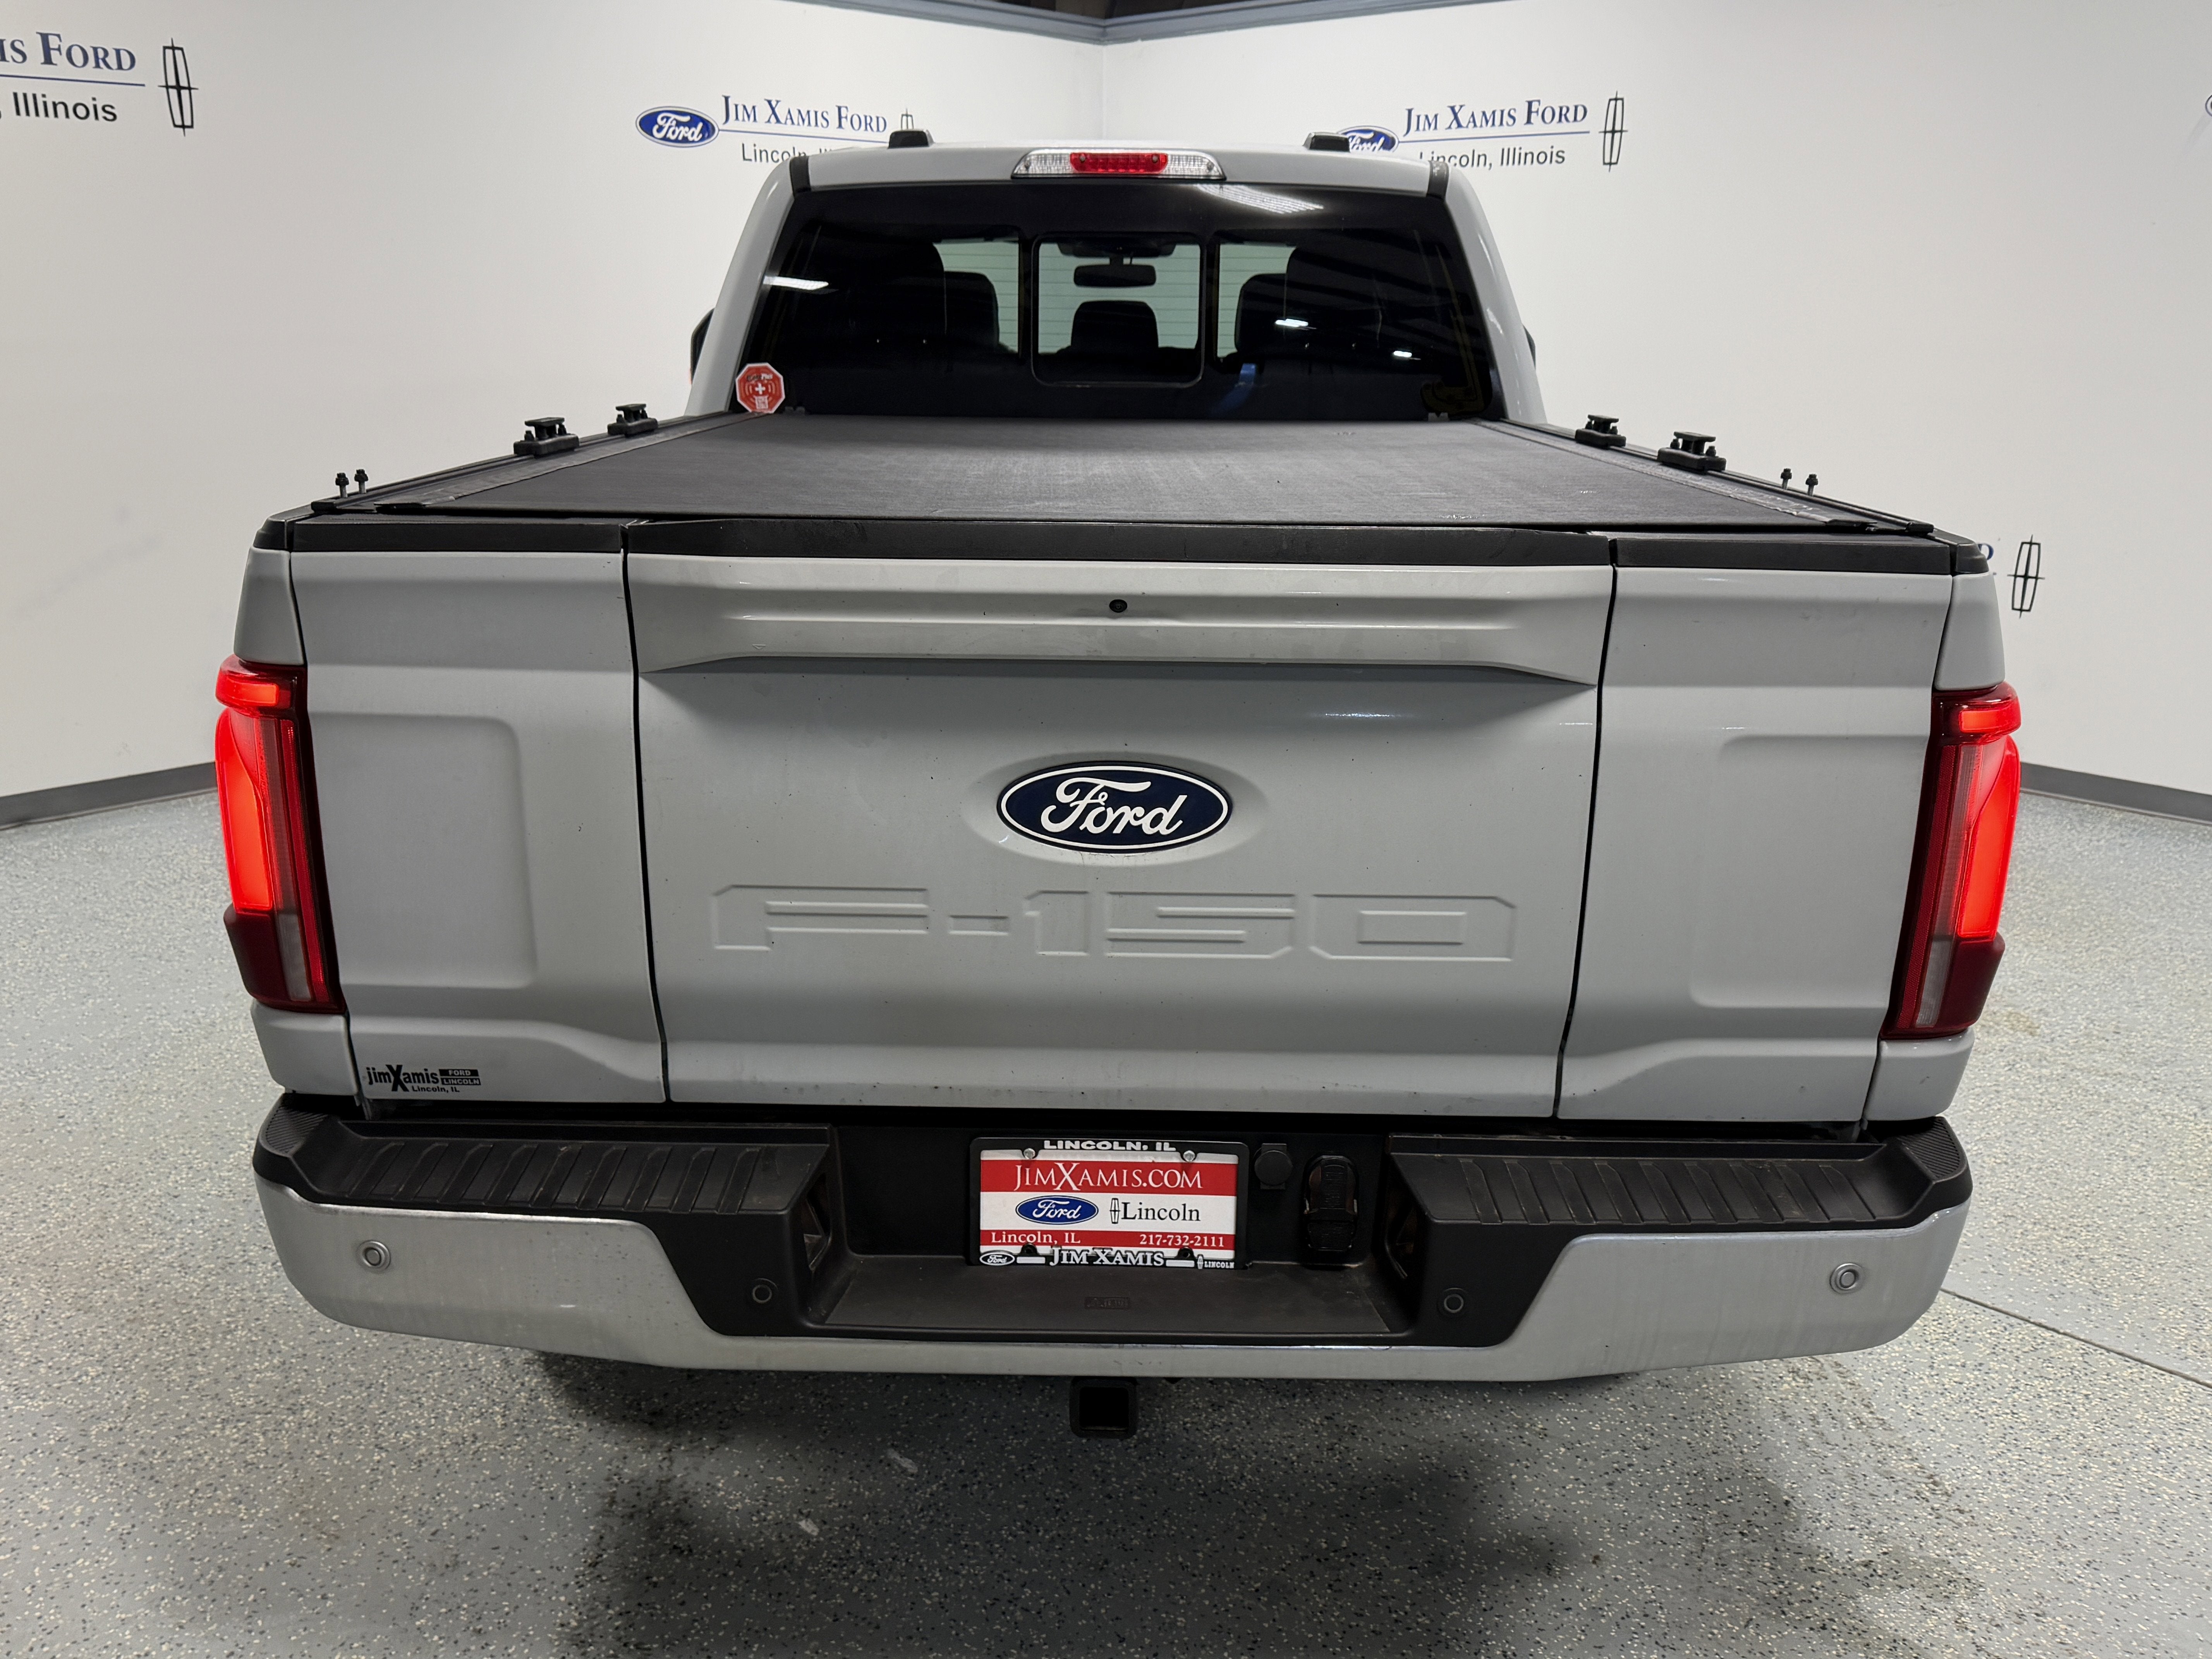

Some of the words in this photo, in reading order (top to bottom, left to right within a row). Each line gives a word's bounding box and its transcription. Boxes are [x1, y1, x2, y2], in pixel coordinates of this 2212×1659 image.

[36, 32, 136, 71] FORD
[13, 91, 117, 122] Illinois
[722, 95, 757, 125] JIM
[764, 98, 829, 128] XAMIS
[835, 105, 887, 132] FORD
[1403, 108, 1439, 137] JIM
[1445, 104, 1516, 130] XAMIS
[1524, 99, 1588, 125] FORD
[652, 112, 703, 141] Ford
[1500, 145, 1565, 166] Illinois
[1041, 777, 1187, 835] Ford
[711, 884, 1517, 962] F-150
[1044, 1140, 1149, 1151] LINCOLN,
[1156, 1142, 1176, 1152] IL
[1014, 1162, 1204, 1191] JIMXAMIS.COM
[1032, 1200, 1081, 1219] Ford
[1121, 1202, 1201, 1221] Lincoln
[991, 1231, 1058, 1244] Lincoln,
[1065, 1232, 1081, 1243] IL
[1139, 1234, 1224, 1247] 217-732-2111
[987, 1255, 1008, 1264] Ford
[1049, 1246, 1089, 1266] JIM
[1092, 1247, 1164, 1267] XAMIS
